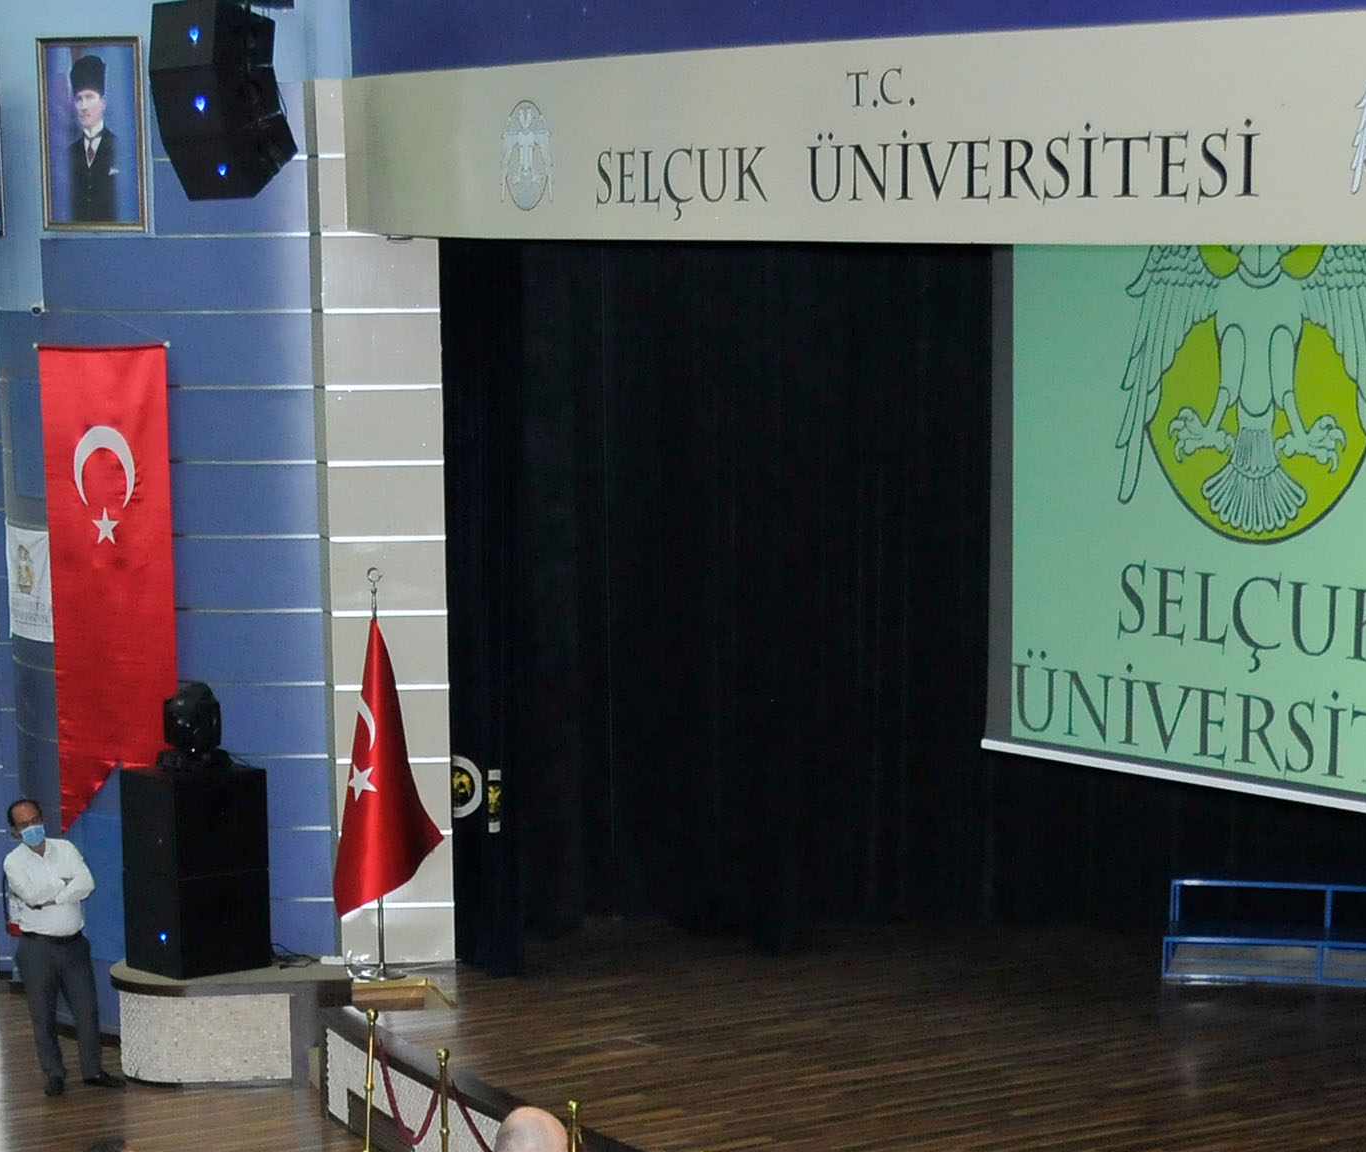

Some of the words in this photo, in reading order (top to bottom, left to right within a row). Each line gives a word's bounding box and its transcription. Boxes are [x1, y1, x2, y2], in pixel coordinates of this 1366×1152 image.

[845, 64, 916, 109] T.C.
[595, 143, 768, 222] SELÇUK
[806, 117, 1262, 206] ÜNİVERSİTESİ
